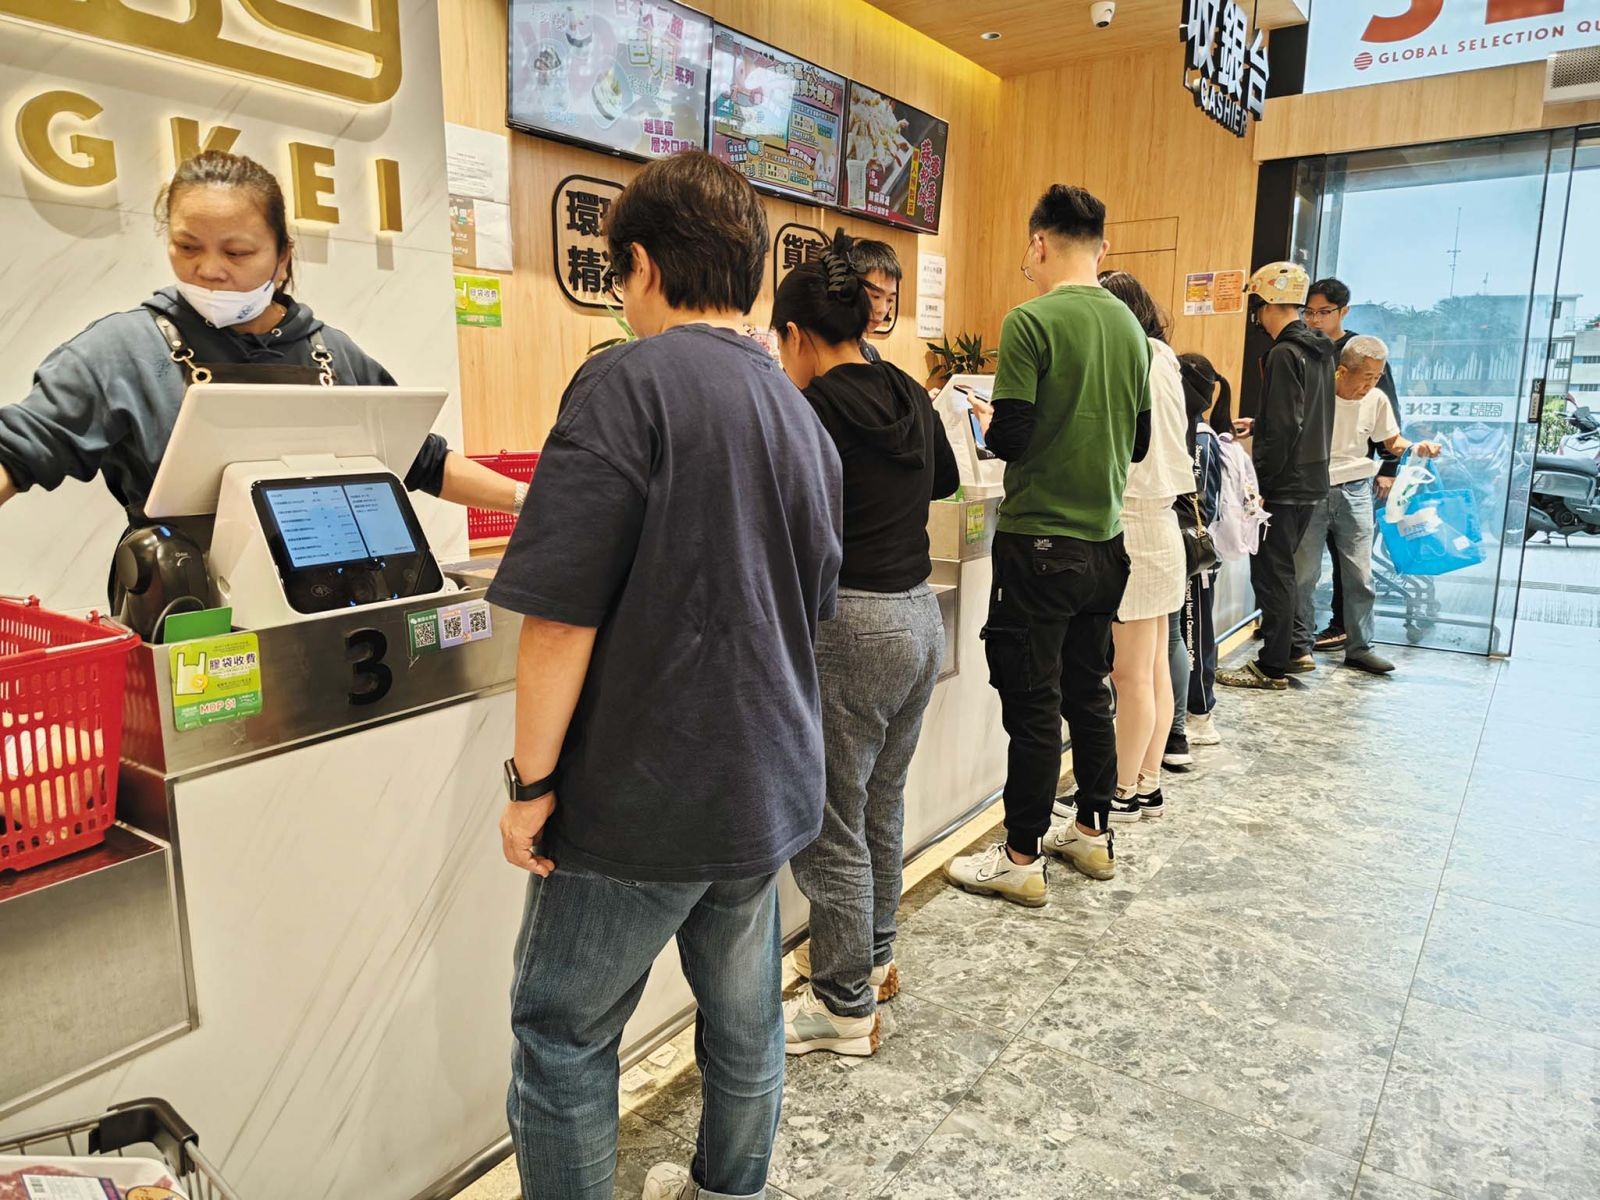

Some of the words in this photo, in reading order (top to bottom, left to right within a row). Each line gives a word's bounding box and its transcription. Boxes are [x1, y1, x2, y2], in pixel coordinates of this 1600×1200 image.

[1378, 44, 1448, 64] GLOBAL
[1457, 24, 1565, 52] SELECTION
[675, 65, 695, 87] 系列
[1180, 0, 1269, 121] 收銀台
[1200, 77, 1248, 136] CASHIER
[1194, 445, 1203, 466] Sacred
[1185, 580, 1194, 601] Sacred
[1185, 602, 1194, 619] Heart
[345, 627, 393, 706] 3
